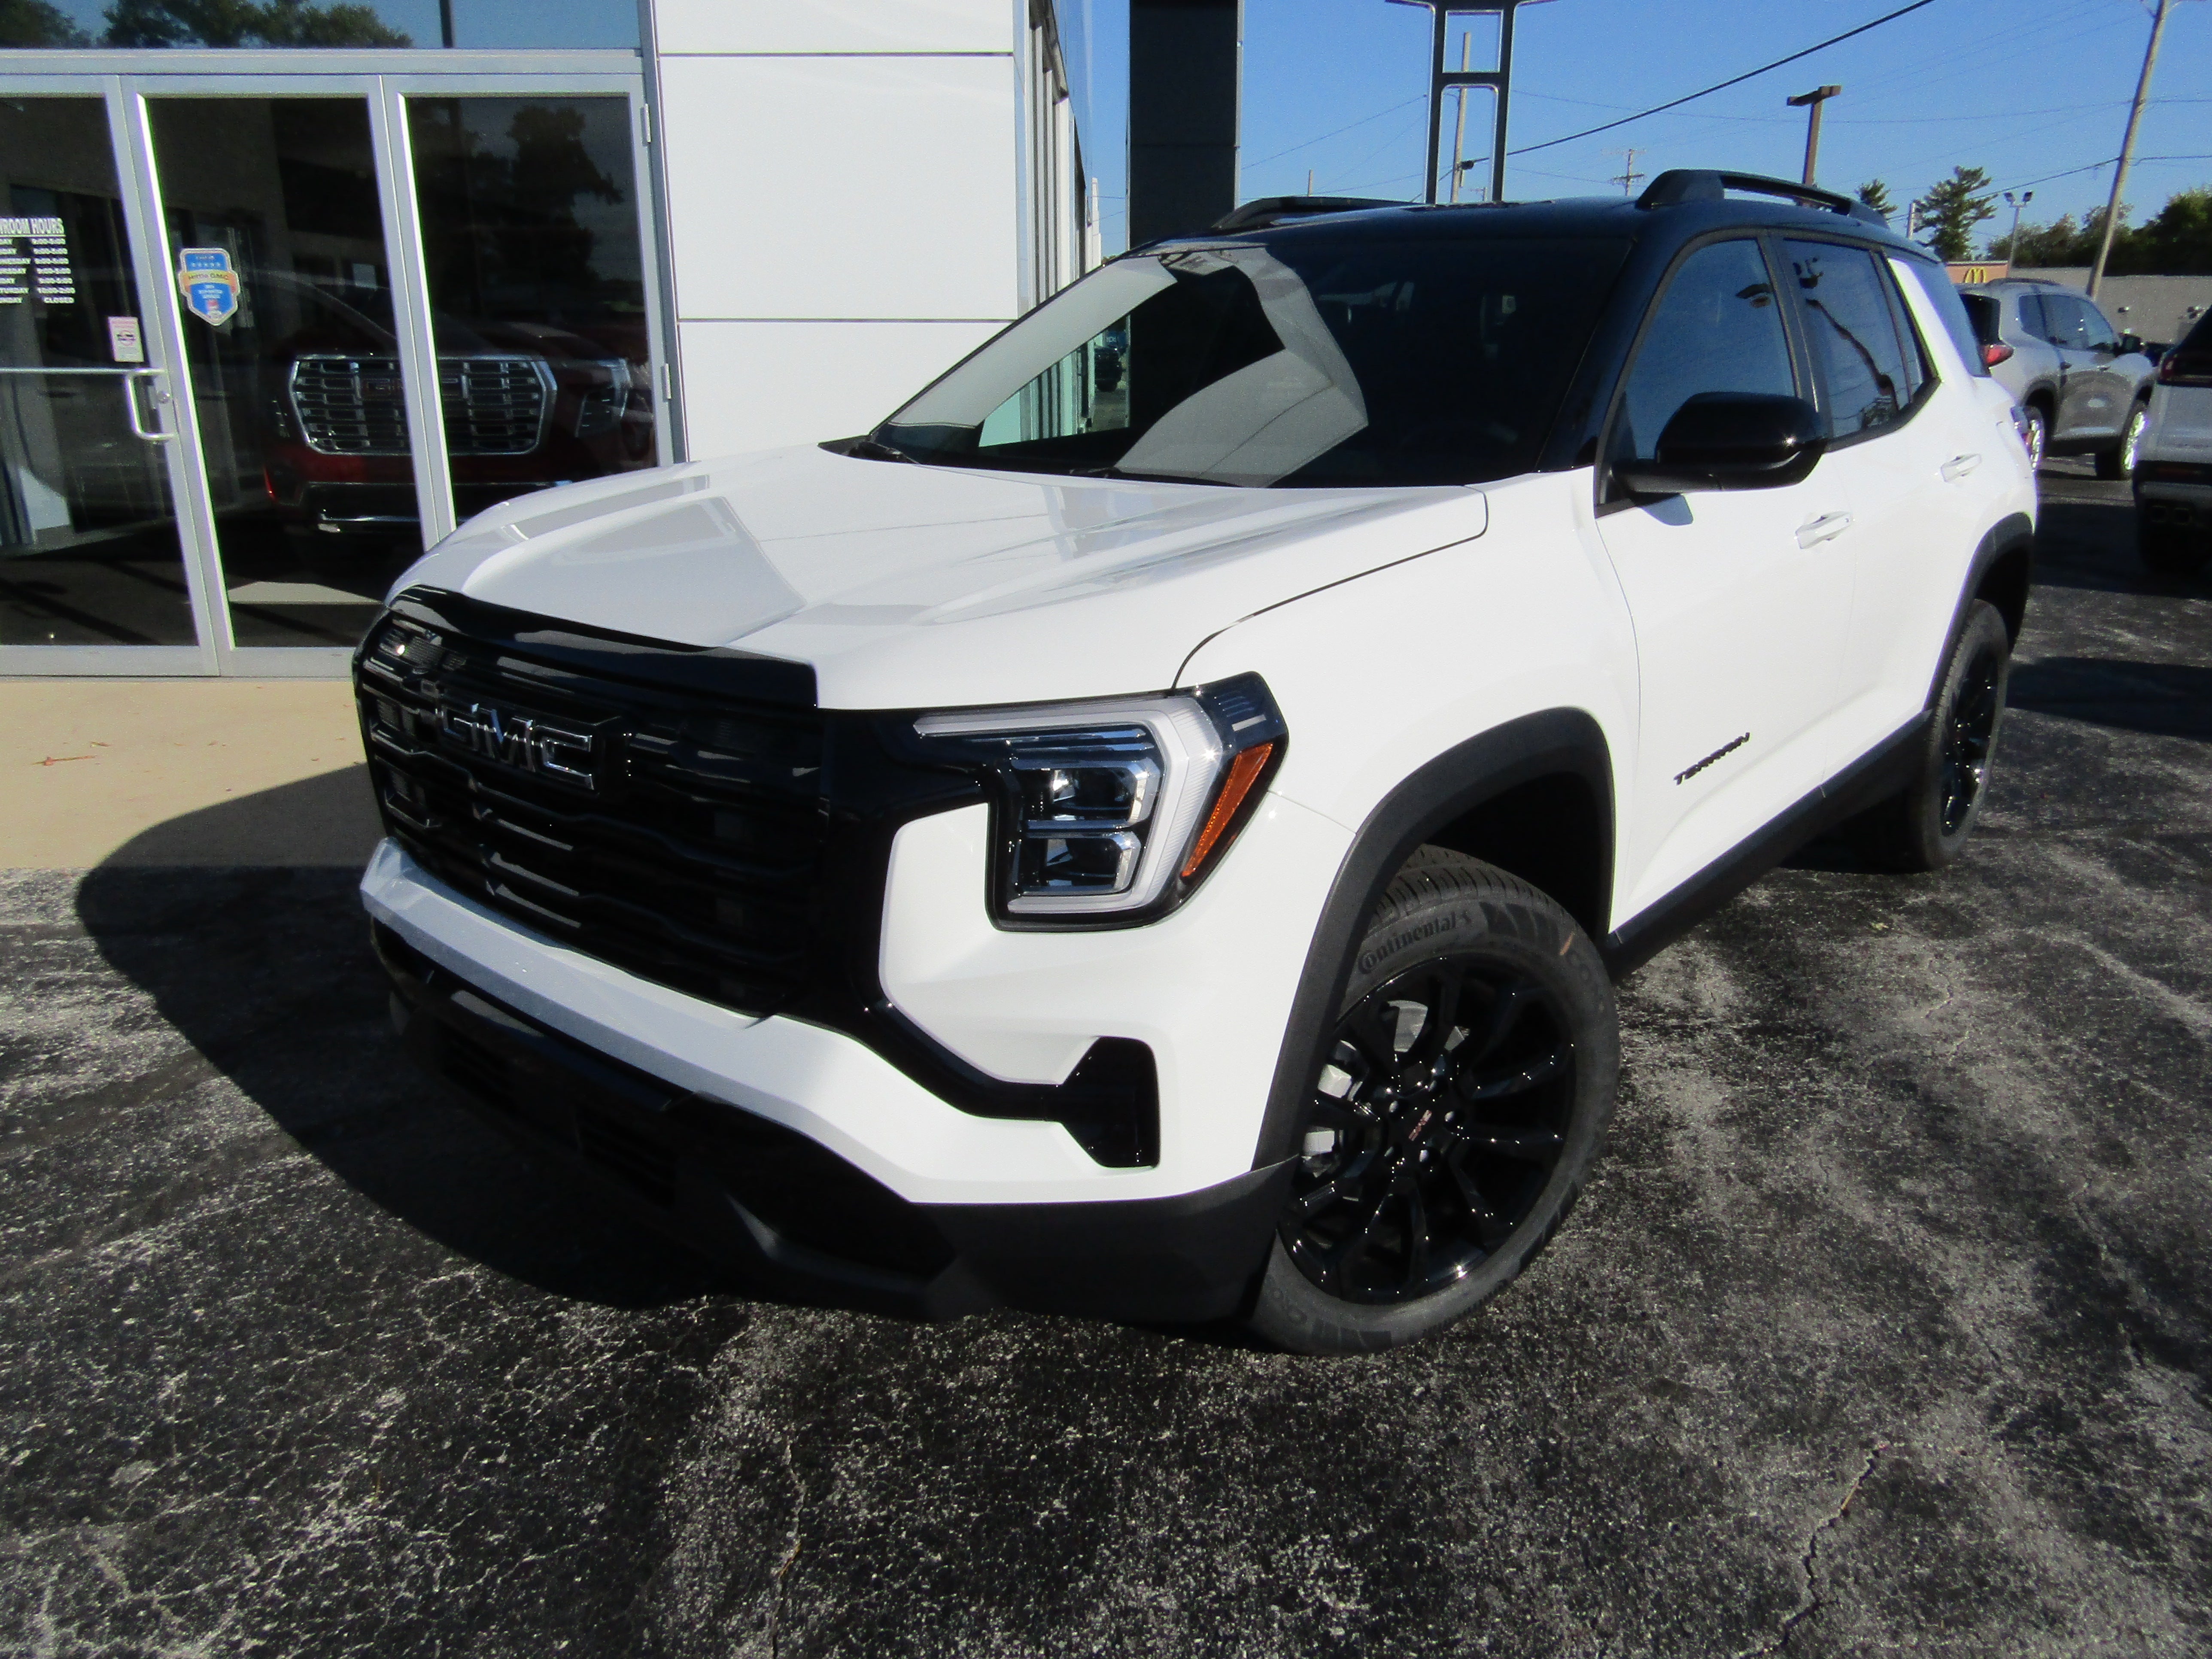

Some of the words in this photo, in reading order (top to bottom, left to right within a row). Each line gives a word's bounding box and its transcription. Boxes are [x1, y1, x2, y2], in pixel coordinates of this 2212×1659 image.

[30, 217, 64, 234] HOURS
[435, 703, 595, 790] GMC
[1358, 910, 1456, 975] Continental
